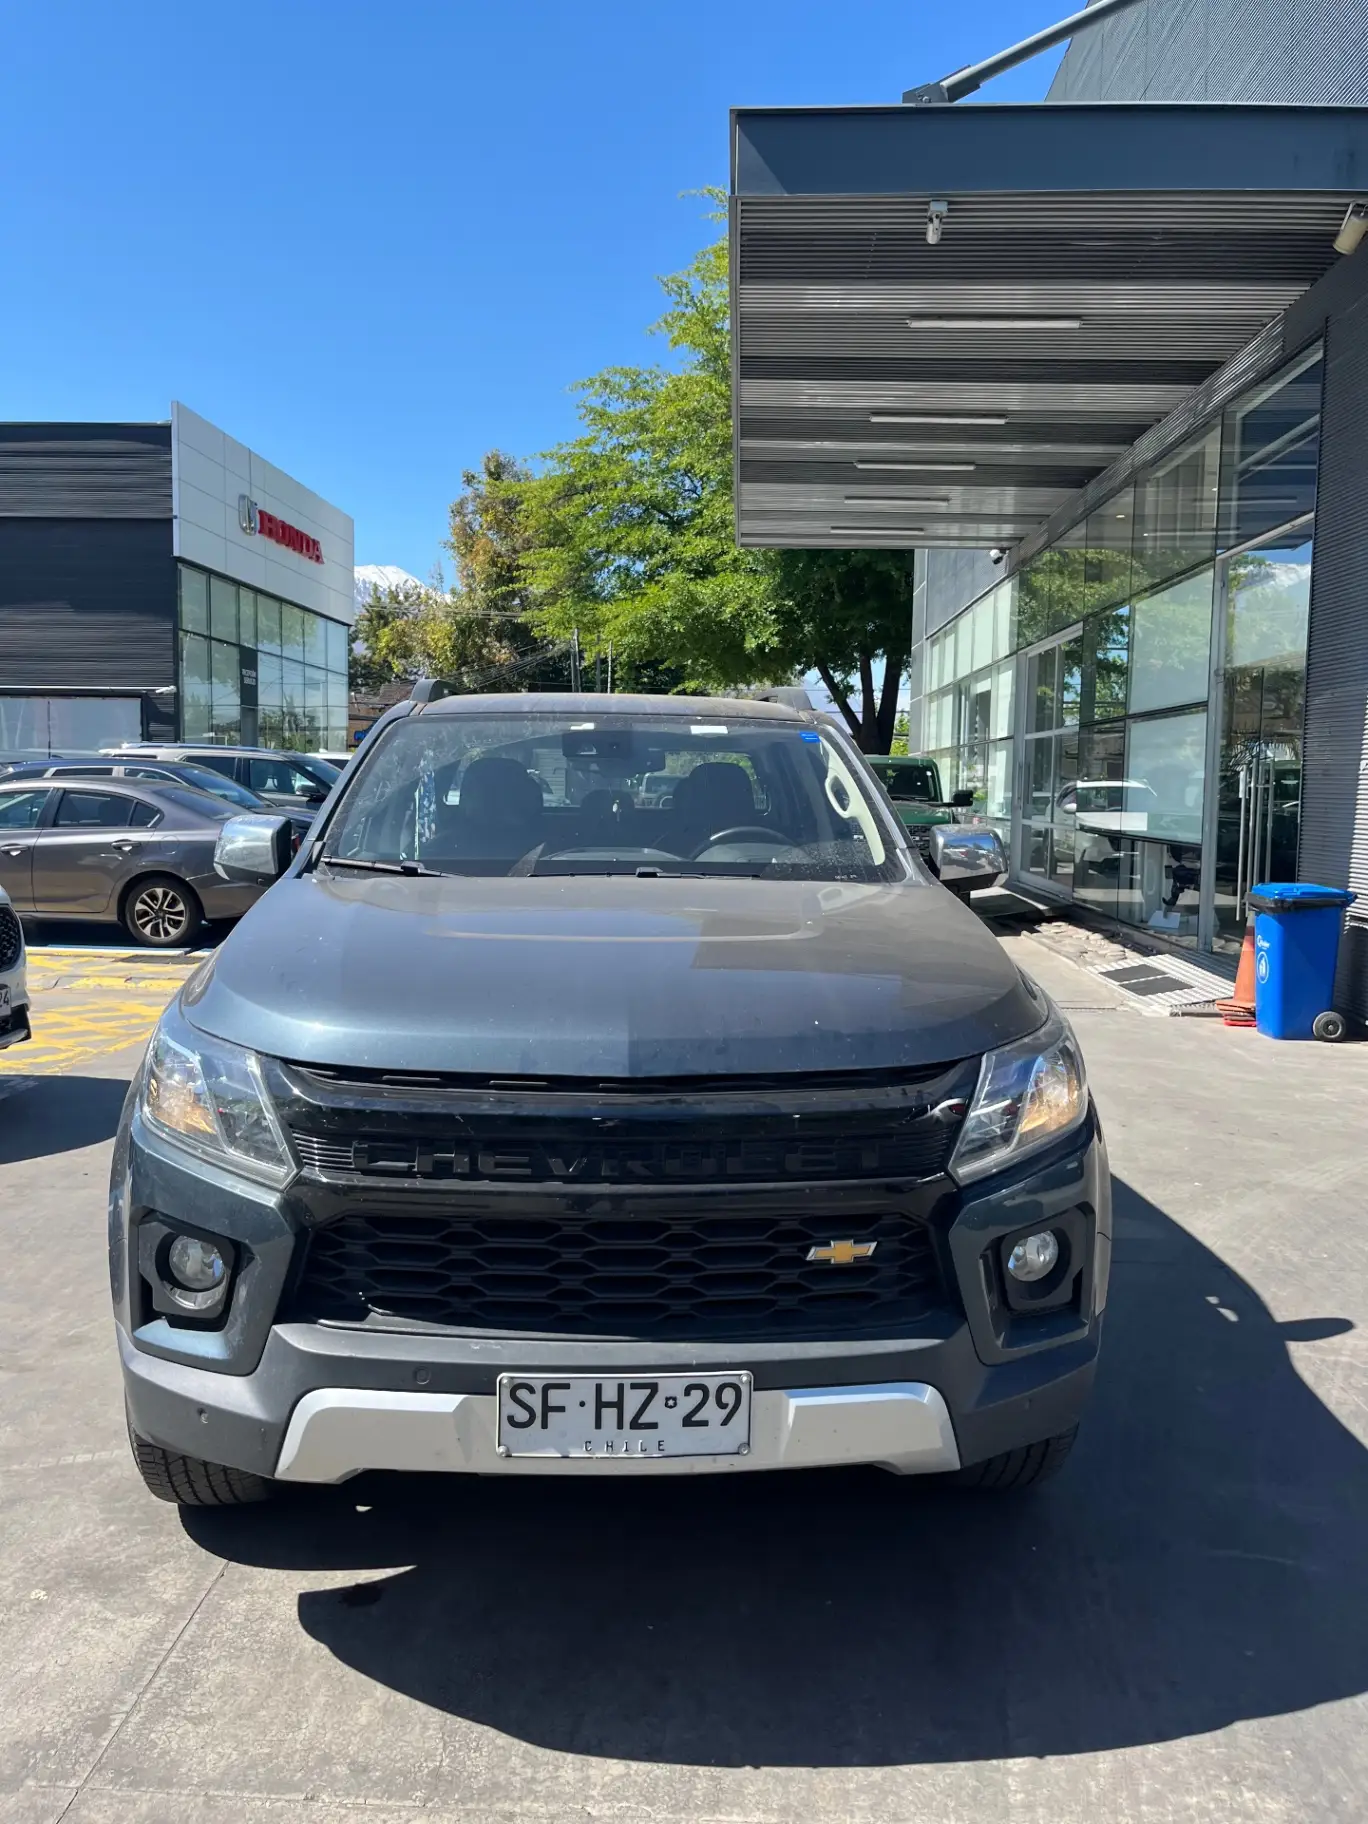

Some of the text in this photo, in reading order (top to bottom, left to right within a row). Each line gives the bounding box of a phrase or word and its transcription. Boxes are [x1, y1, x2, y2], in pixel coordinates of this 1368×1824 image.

[258, 509, 325, 565] HONDA
[352, 1140, 893, 1178] CHEVROLET
[583, 1439, 666, 1453] CHILE
